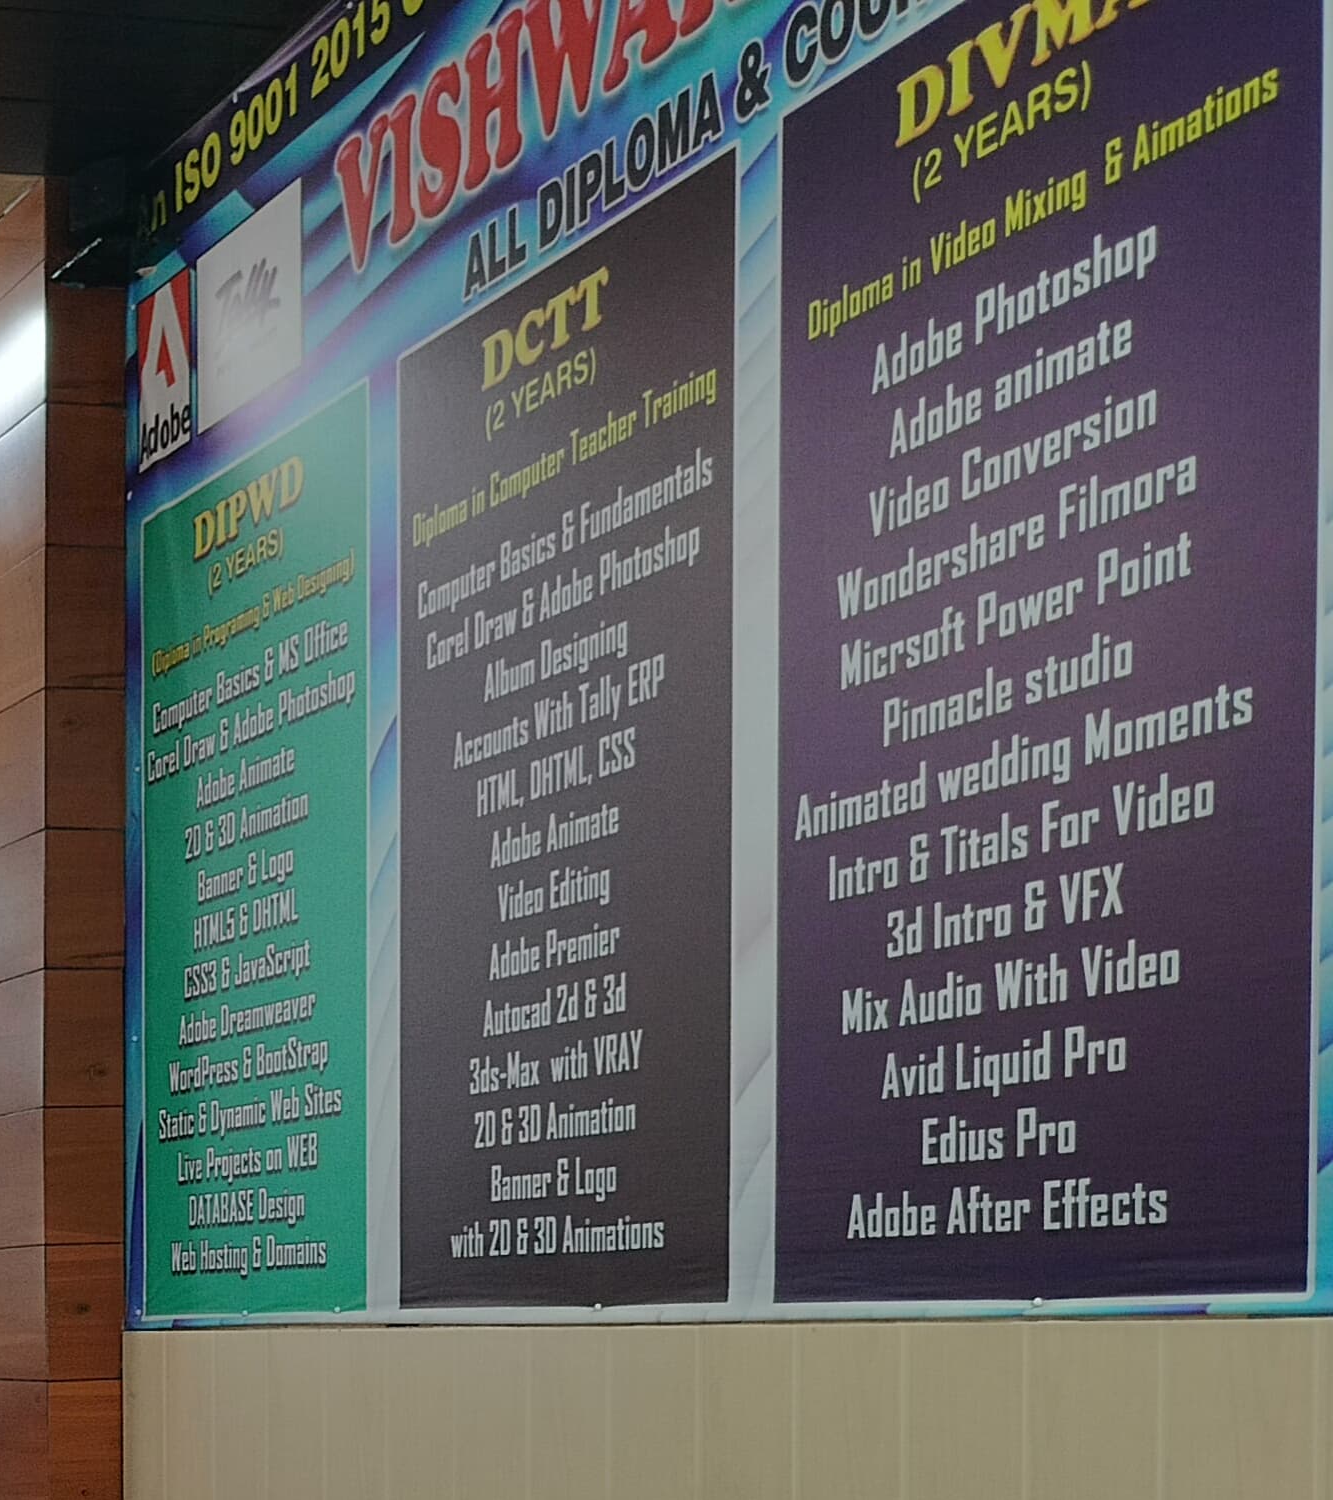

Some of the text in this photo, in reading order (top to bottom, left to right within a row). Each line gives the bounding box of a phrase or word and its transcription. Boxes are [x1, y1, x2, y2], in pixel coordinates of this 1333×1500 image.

[175, 0, 391, 213] ISO 9001 2015
[895, 0, 1154, 148] DIVM
[463, 207, 526, 298] ALL
[538, 74, 722, 249] DIPLOMA
[735, 43, 769, 121] &
[913, 61, 1092, 202] (2 YEARS)
[807, 68, 1280, 340] Diploma in Video Mixing & Aimations
[480, 266, 609, 391] DCTT
[872, 225, 1157, 395] Adobe Photoshop
[141, 403, 190, 459] Adobe
[485, 348, 598, 442] (2 YEARS)
[194, 455, 303, 560] DIPWD
[869, 389, 1156, 537] Video Conversion
[207, 528, 283, 597] (2 YEARS)
[418, 559, 495, 619] Computer
[500, 532, 556, 582] Basics
[562, 506, 574, 552] &
[581, 447, 713, 544] Fundamentals
[837, 455, 1197, 620] Wondershare Filmora
[840, 531, 1192, 690] Micrsoft Power Point
[883, 632, 1133, 747] Pinnacle studio
[795, 684, 1253, 840] Animated wedding Moments
[179, 994, 316, 1047] Adobe Dreamweaver
[184, 940, 310, 999] CSS3 & JavaScript
[169, 1037, 329, 1093] WordPress & BootStrap
[469, 1030, 643, 1095] 3ds-Max with VRAY
[882, 1025, 1126, 1100] Avid Liquid Pro
[491, 1157, 617, 1202] Banner & Logo
[922, 1107, 1076, 1165] Edius Pro
[171, 1236, 327, 1275] Web Hosting & Domains
[189, 1189, 305, 1226] DATABASE Design
[847, 1177, 1168, 1239] Adobe After Effects
